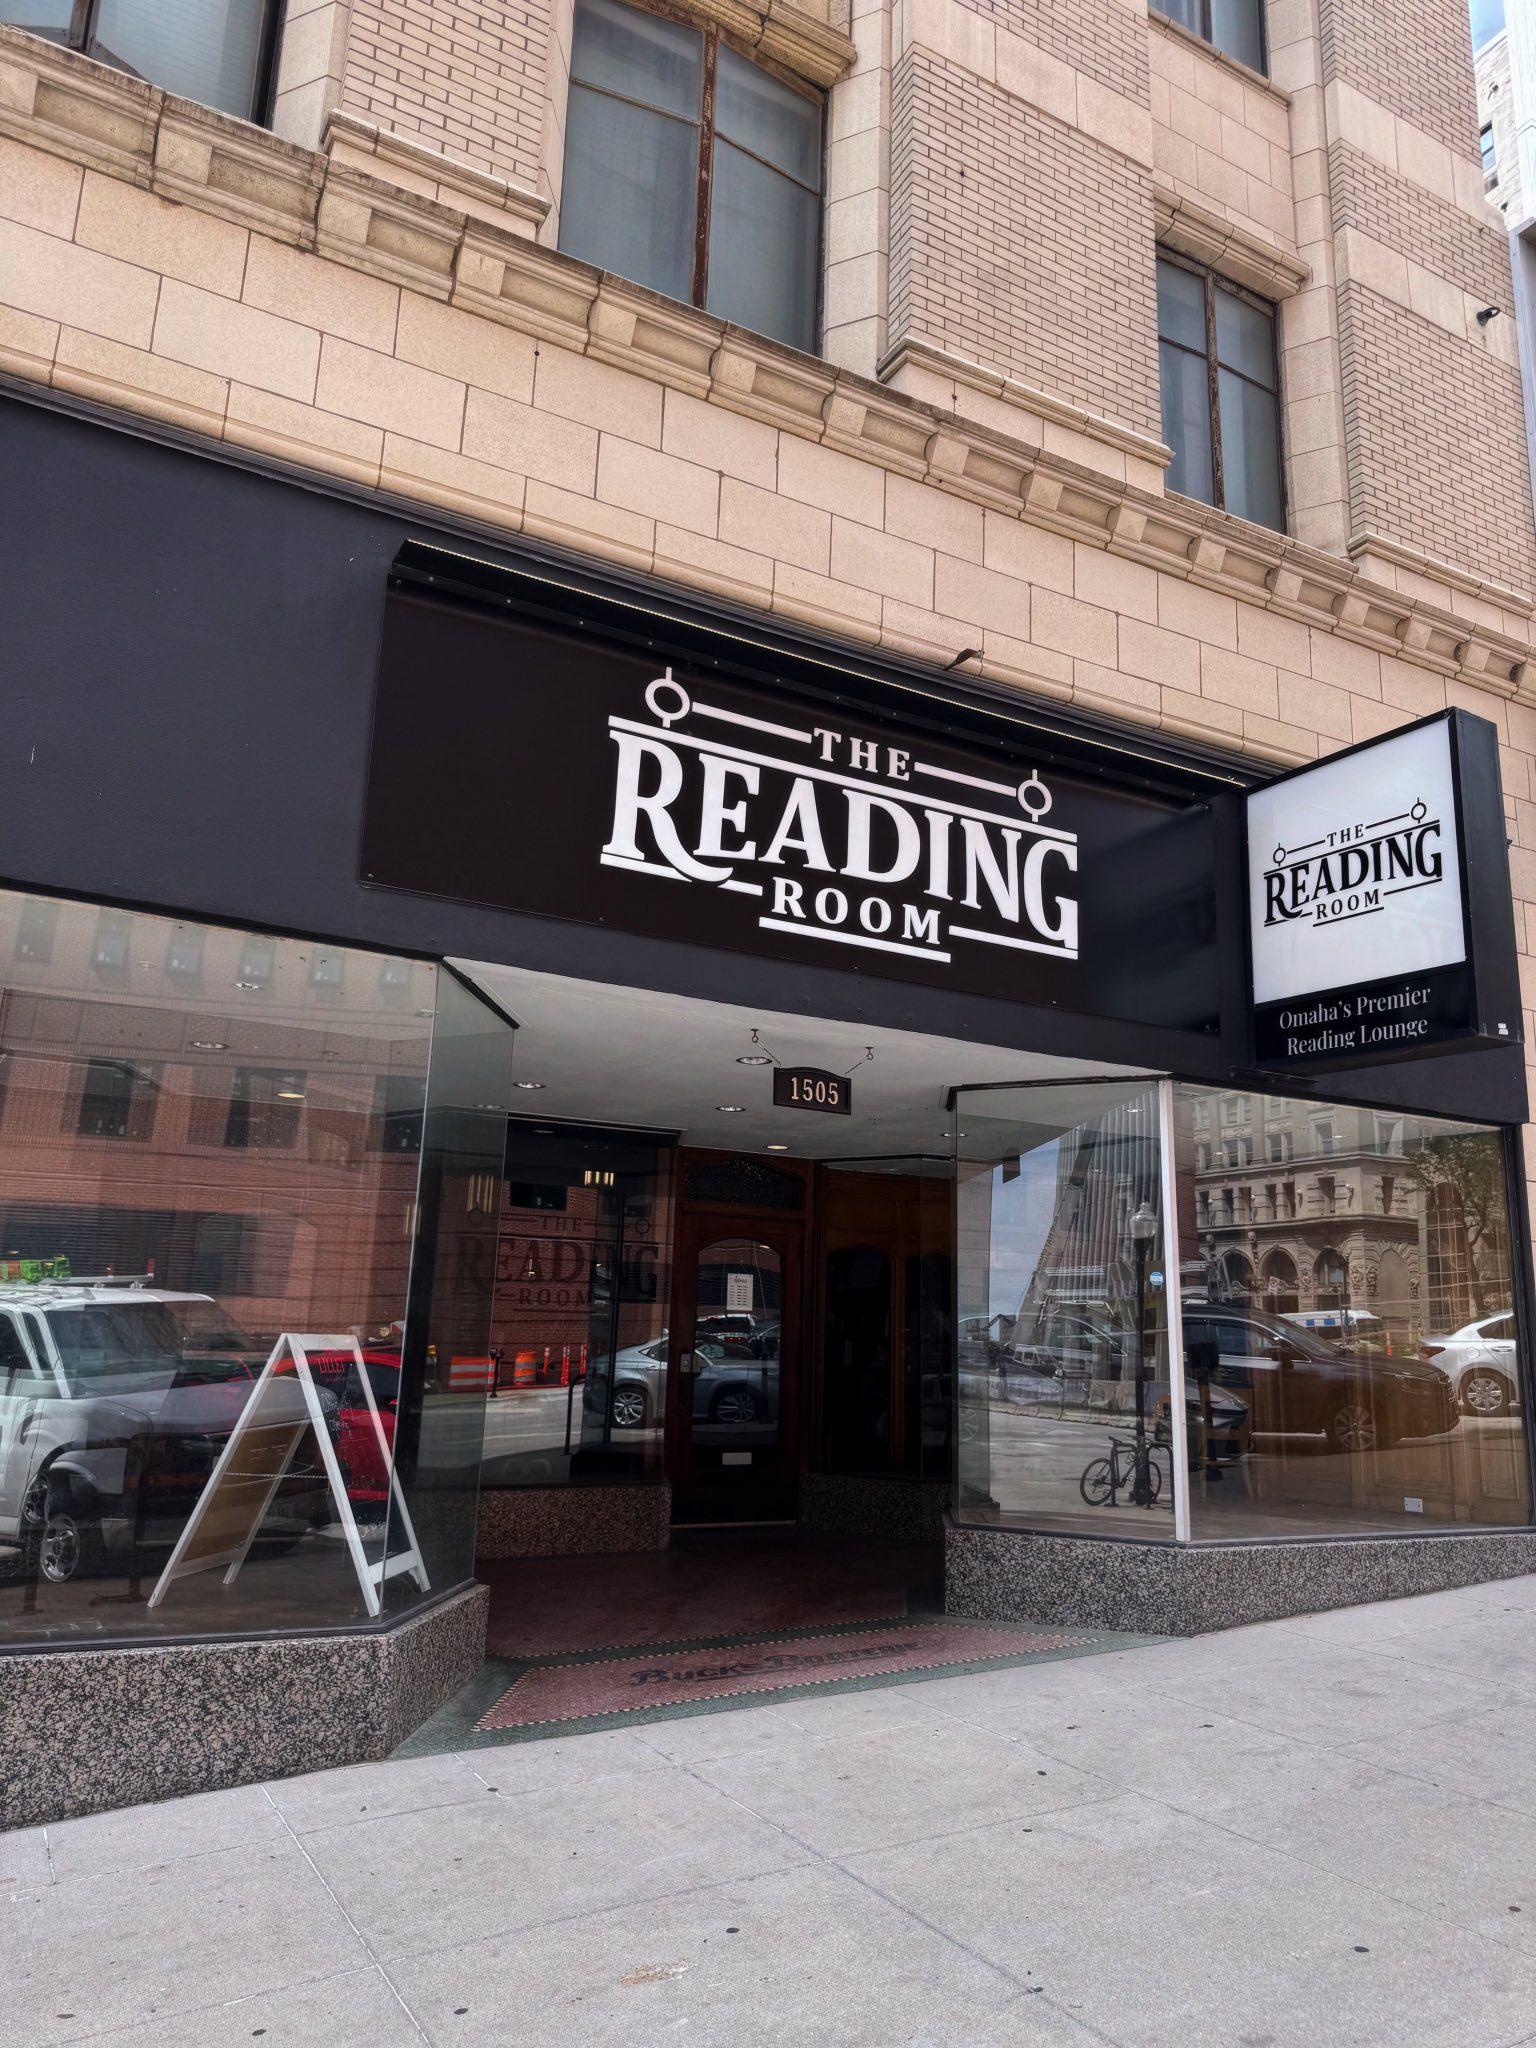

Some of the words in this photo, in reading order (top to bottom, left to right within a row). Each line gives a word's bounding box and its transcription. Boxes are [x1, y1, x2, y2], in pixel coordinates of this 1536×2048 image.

[813, 727, 911, 782] THE
[602, 729, 1079, 949] READING
[1326, 823, 1365, 848] THE
[1263, 824, 1443, 924] READING
[771, 876, 942, 945] ROOM
[1315, 888, 1380, 921] ROOM
[1279, 1000, 1352, 1031] Omaha's
[1356, 986, 1432, 1016] Premier
[1286, 1028, 1356, 1056] Reading
[1360, 1016, 1429, 1044] Lounge
[791, 1076, 839, 1105] 1505
